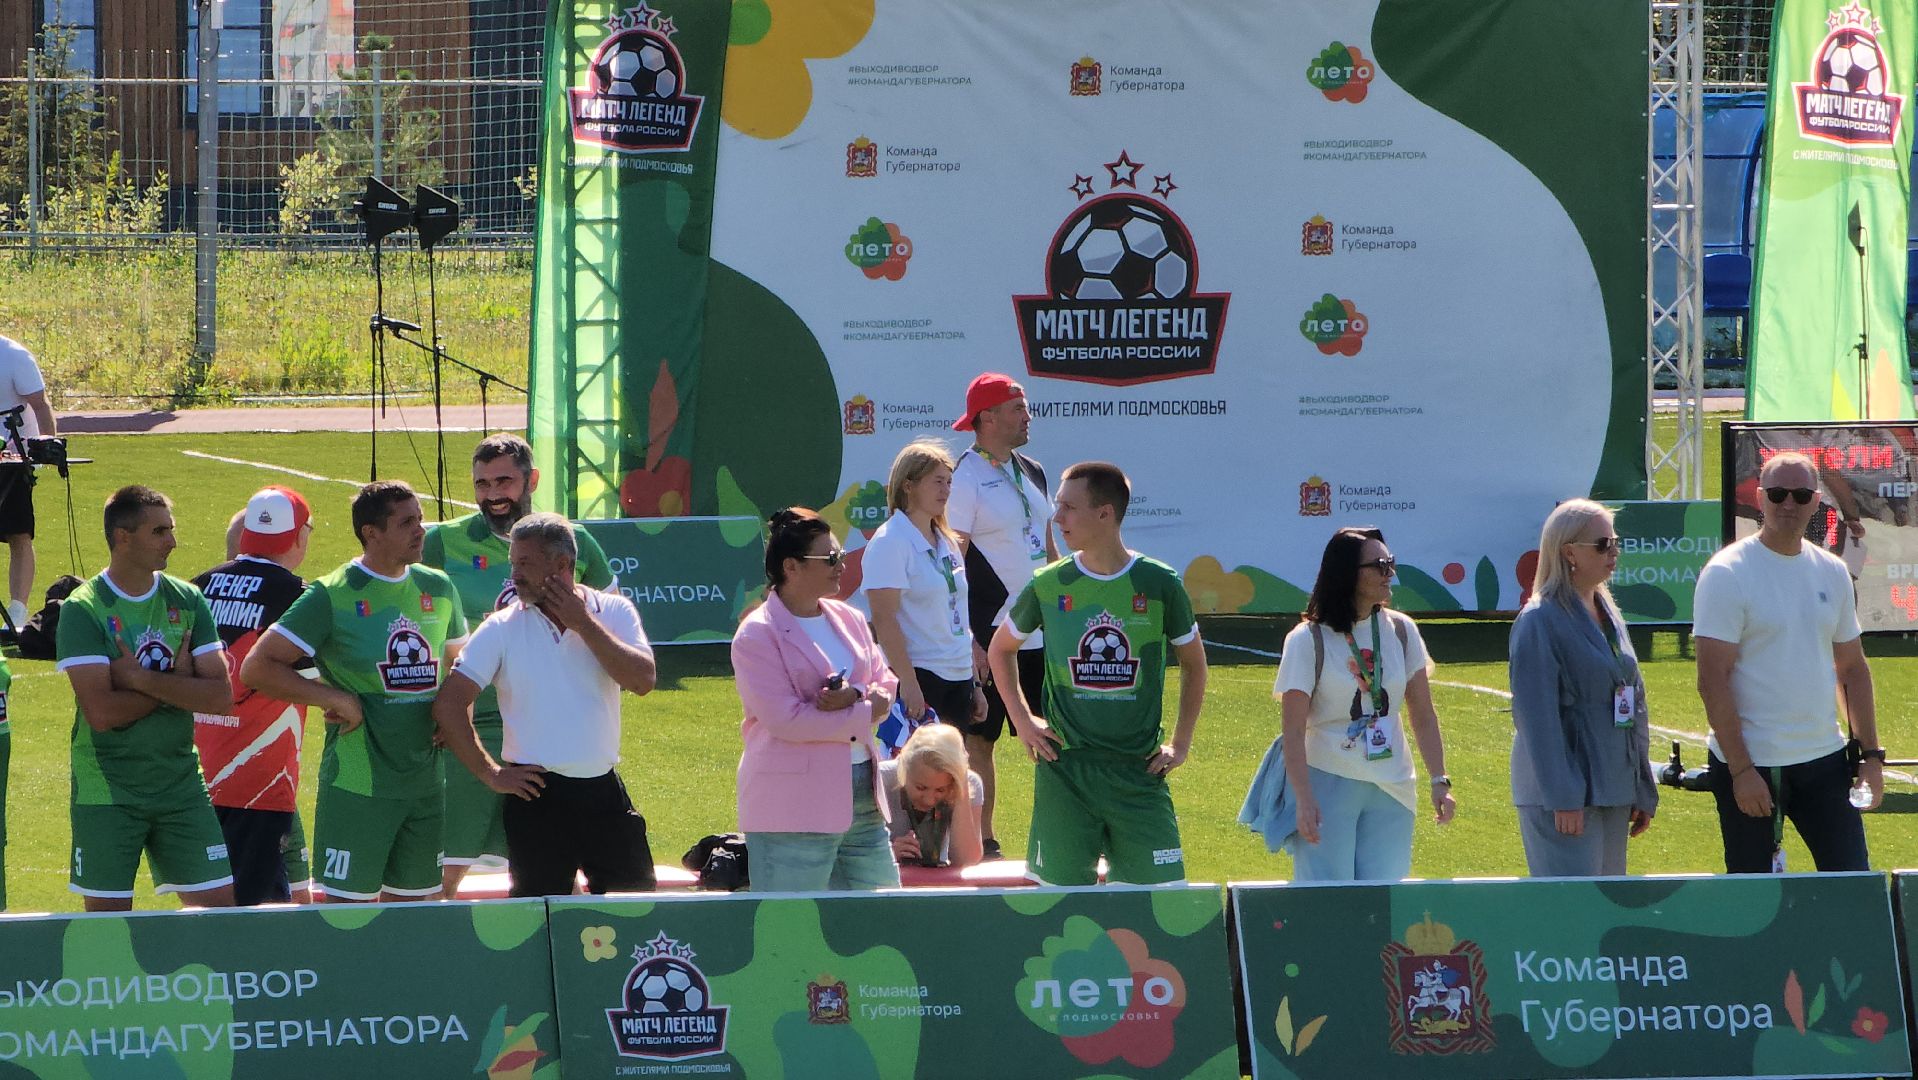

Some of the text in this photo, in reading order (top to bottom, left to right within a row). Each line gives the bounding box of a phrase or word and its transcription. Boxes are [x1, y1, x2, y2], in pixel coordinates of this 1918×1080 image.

[1110, 65, 1162, 77] Команда
[1312, 66, 1370, 79] лето
[1109, 80, 1185, 93] Губернатора
[1806, 93, 1842, 115] МАТЧ
[575, 98, 686, 126] МАТЧ ЛЕГЕНД
[584, 122, 680, 137] ФУТБОЛА РОССИИ
[1809, 116, 1890, 134] ФУТБОЛА РОССИИ
[886, 146, 938, 158] Команда
[630, 158, 693, 175] ПОДМОСКОВЬЯ
[886, 161, 961, 174] Губернатора
[1341, 224, 1394, 236] Команда
[850, 243, 909, 257] лето
[1341, 239, 1417, 252] Губернатора
[1035, 307, 1209, 341] МАТЧ ЛЕГЕНД
[1305, 319, 1364, 333] лето
[1042, 345, 1201, 361] ФУТБОЛА РОССИИ
[882, 403, 934, 415] Команда
[1029, 400, 1226, 417] ЖИТЕЛЯМИ ПОДМОСКОВЬЯ
[1339, 484, 1391, 497] Команда
[850, 506, 889, 519] лет
[1339, 500, 1416, 513] Губернатора
[1619, 536, 1722, 556] ВЫХОД
[1612, 565, 1702, 586] #КОМА
[203, 572, 263, 599] ТРЕНЕР
[1076, 662, 1132, 675] МАТЧ ЛЕГЕНД
[323, 847, 351, 880] 20
[1514, 949, 1689, 986] Команда
[859, 984, 929, 999] Команда
[1031, 976, 1175, 1009] лето
[860, 1003, 961, 1020] Губернатора
[622, 1015, 718, 1035] МАТЧ ЛЕГЕНД
[1518, 999, 1774, 1040] Губернатора
[627, 1035, 714, 1045] ФУТБОЛА РОССИИ
[615, 1063, 731, 1076] С ЖИТЕЛЯМИ ПОДМОСКОВЬЯ
